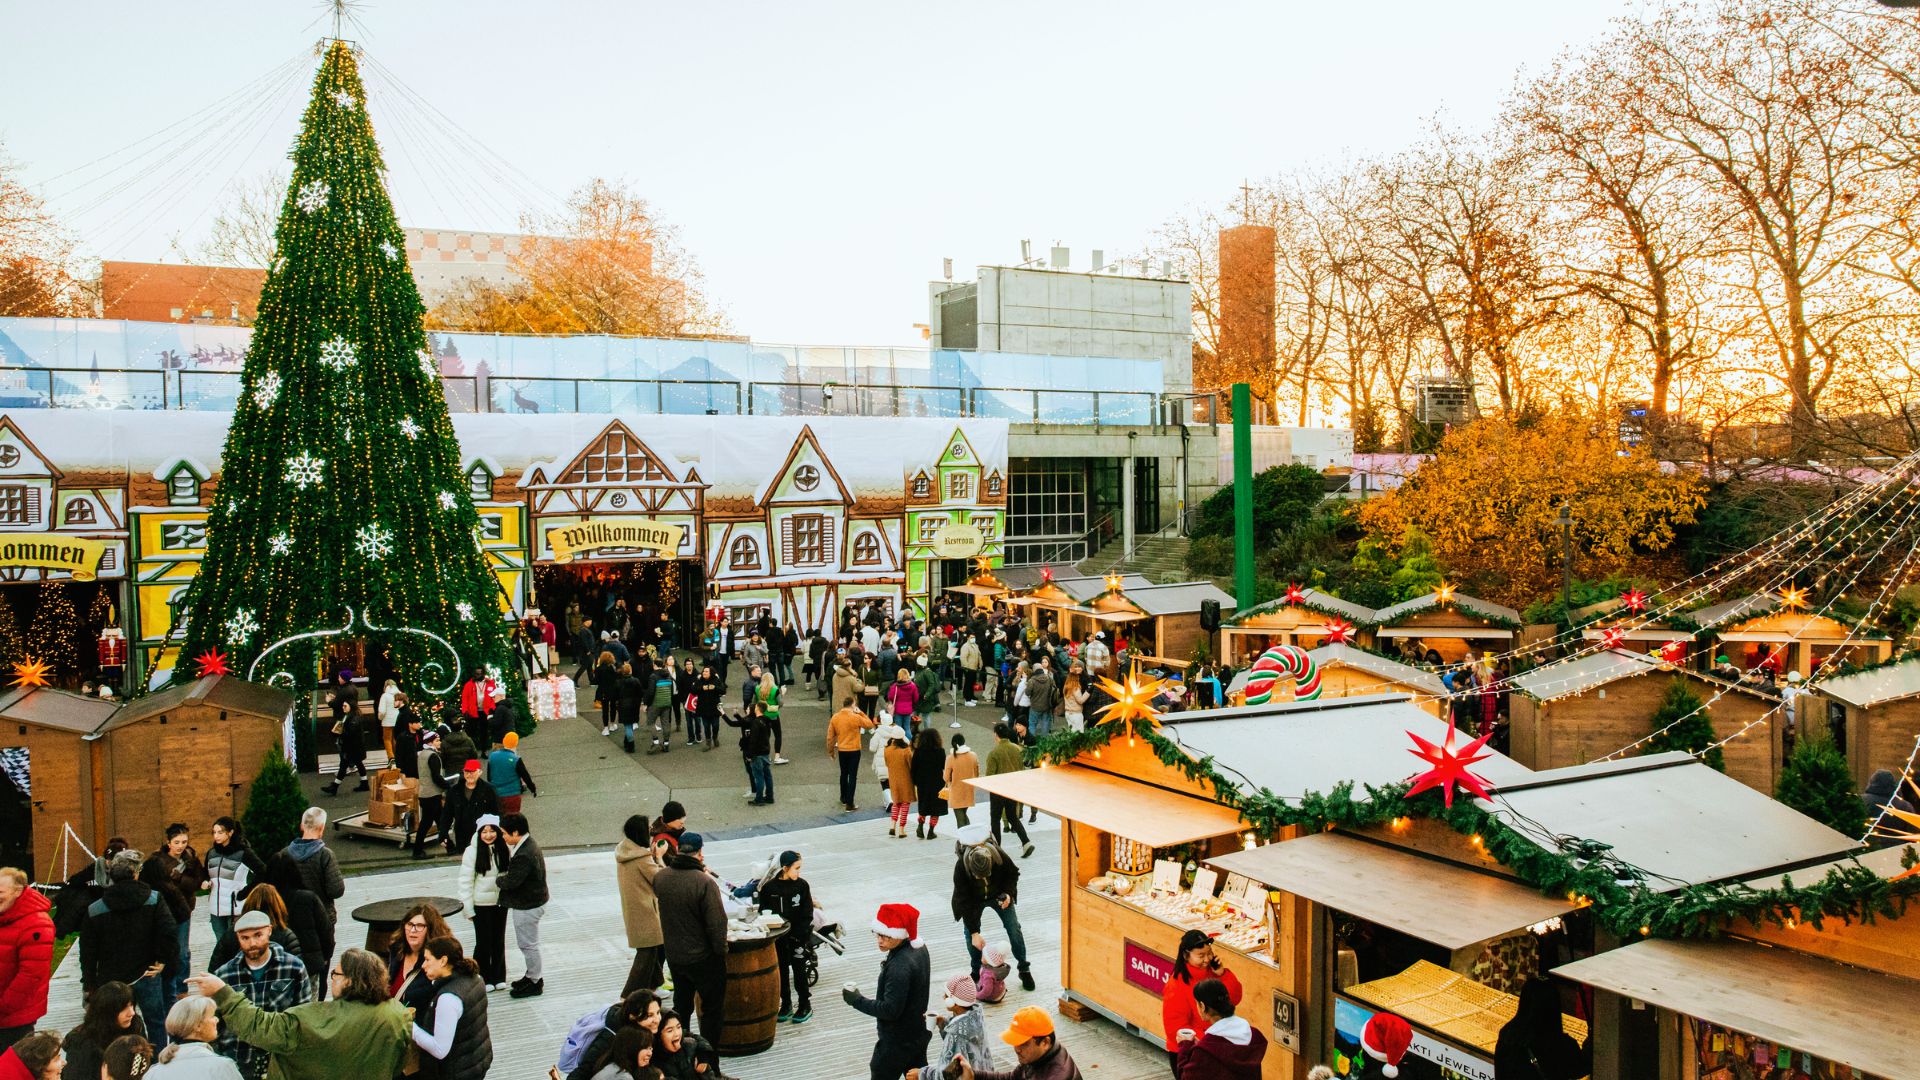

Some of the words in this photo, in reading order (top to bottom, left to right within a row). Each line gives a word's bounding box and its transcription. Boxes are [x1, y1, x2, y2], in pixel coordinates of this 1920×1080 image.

[563, 523, 669, 547] Willkommen
[1131, 957, 1159, 980] SAKTI
[1276, 1001, 1289, 1023] 49
[1436, 1053, 1495, 1080] JEWELRY
